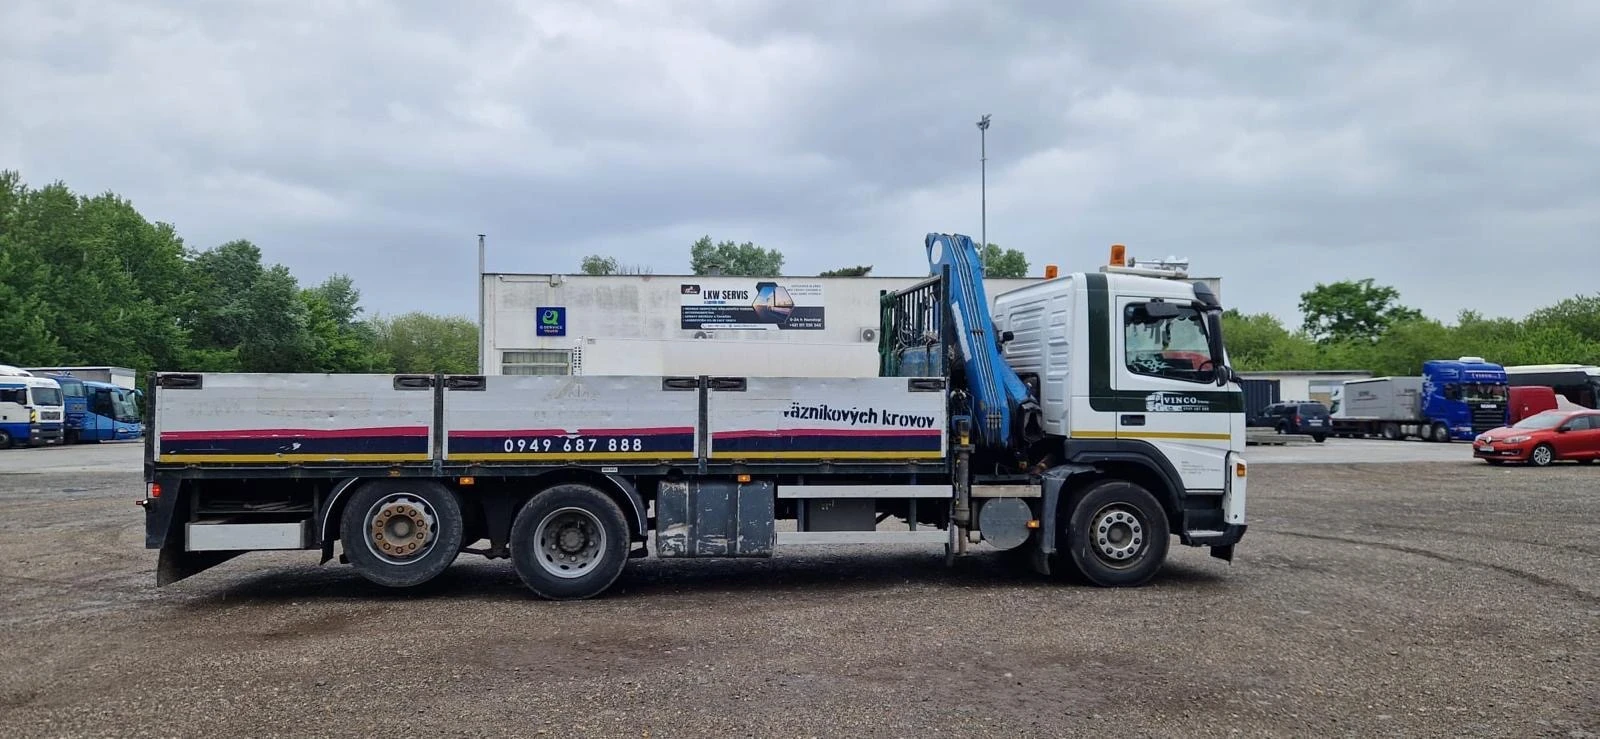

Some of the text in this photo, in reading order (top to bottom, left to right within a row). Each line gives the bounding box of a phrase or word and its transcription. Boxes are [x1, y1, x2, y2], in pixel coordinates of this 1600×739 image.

[703, 290, 749, 300] LKW SERVIS
[882, 409, 935, 429] krovov
[504, 438, 643, 452] 0949 687 888
